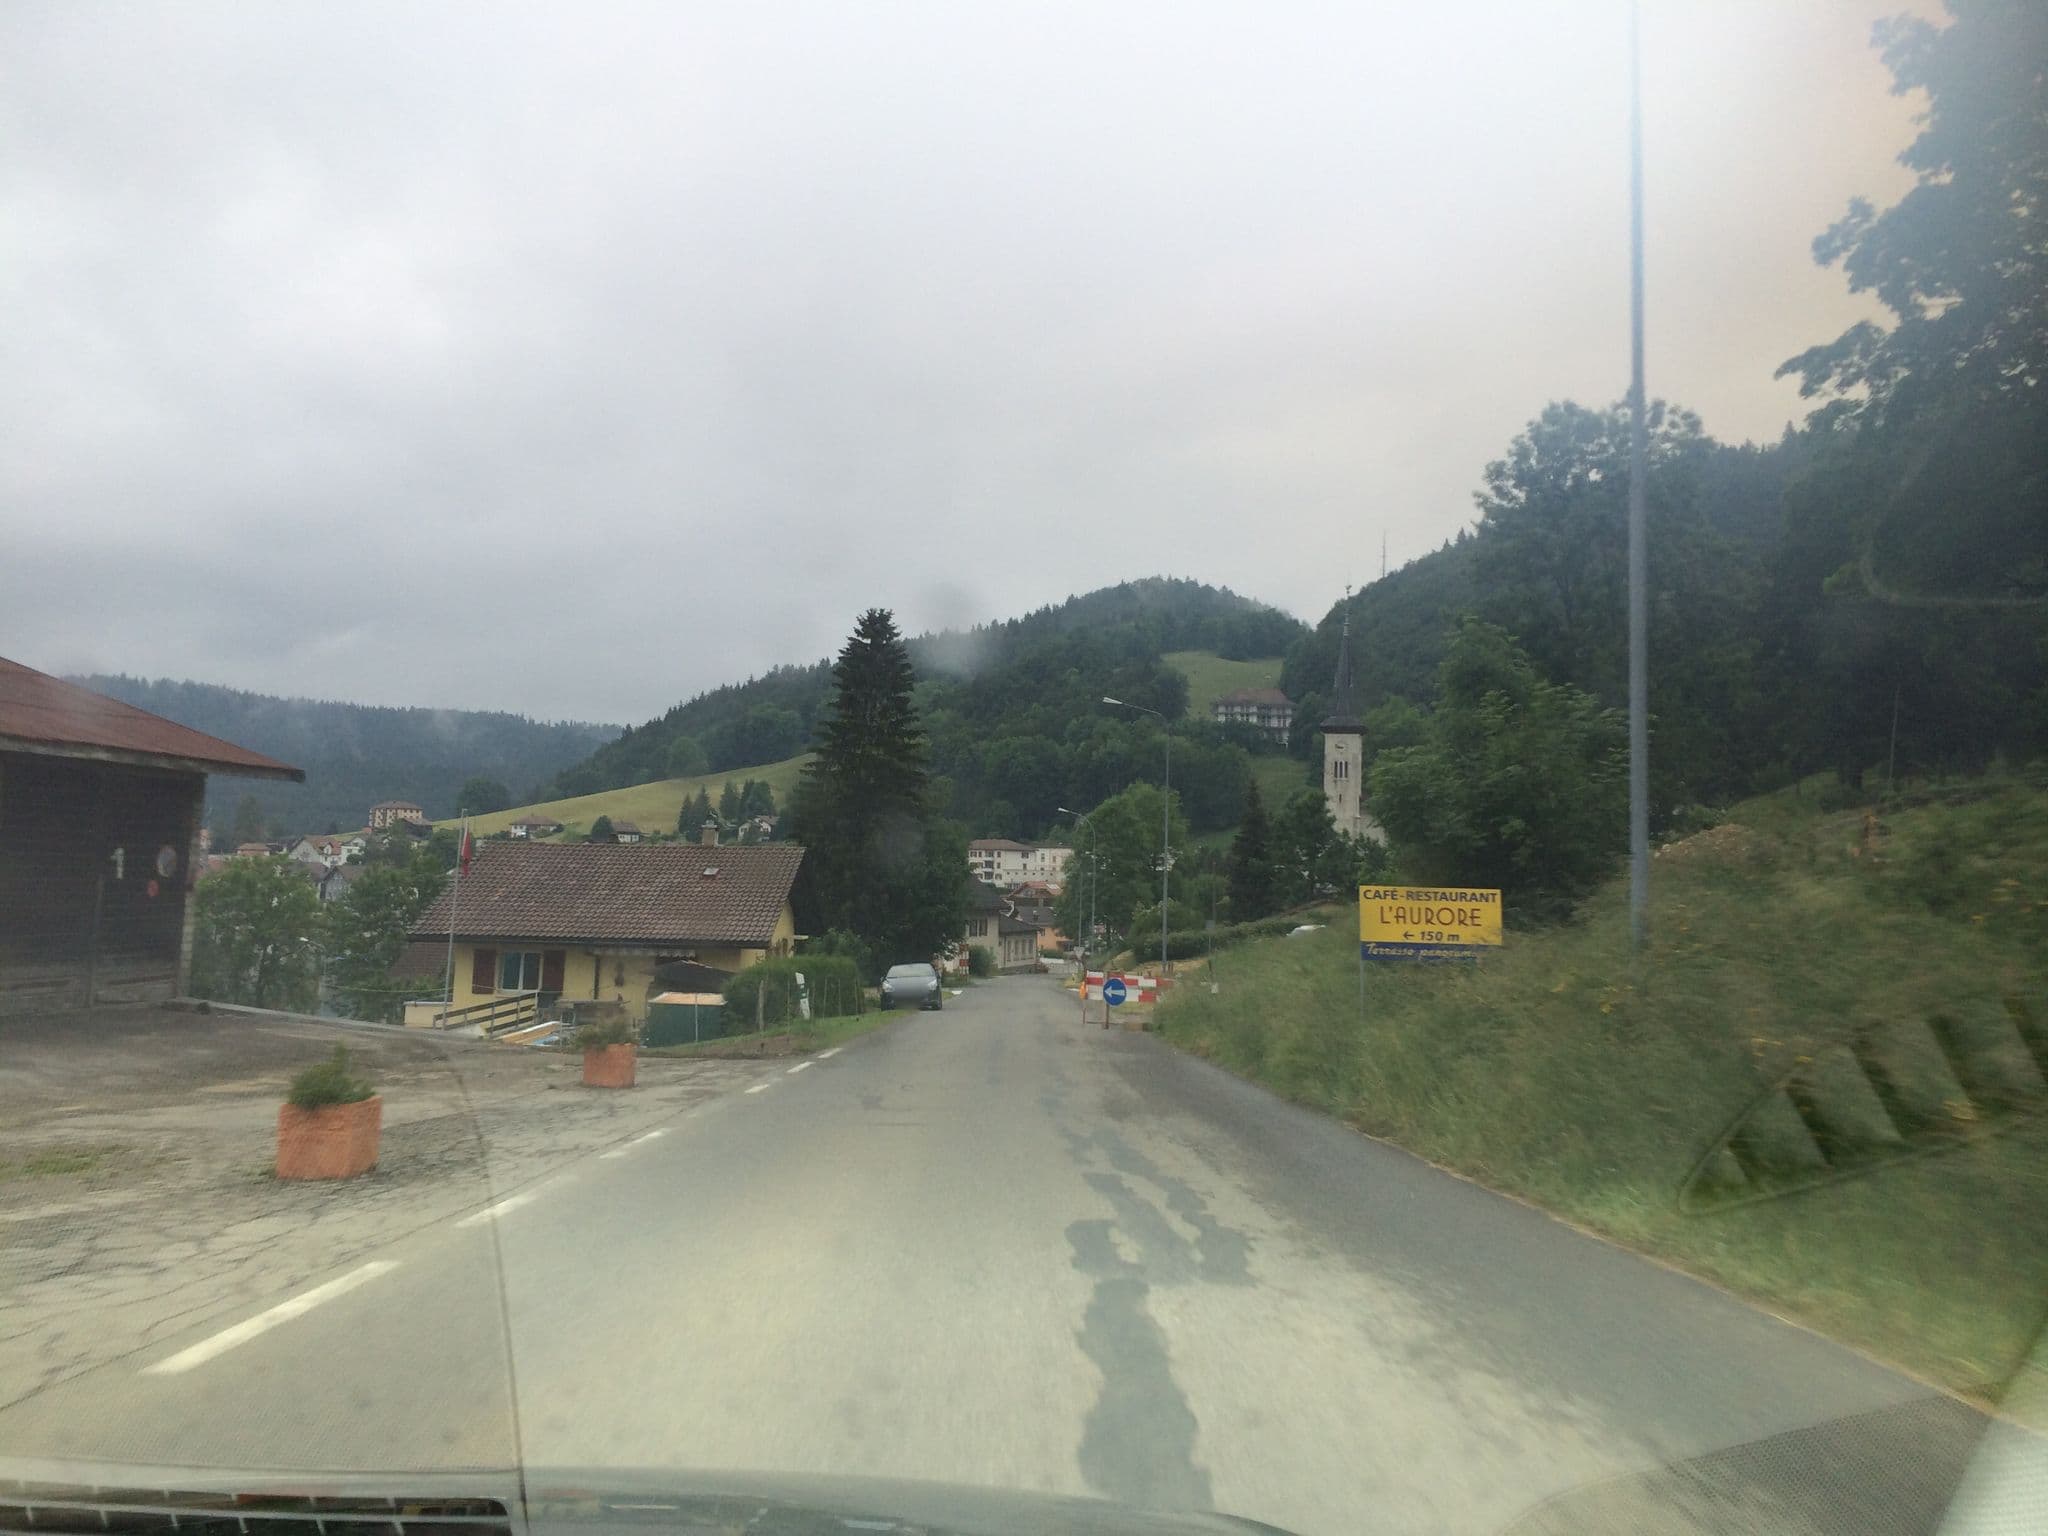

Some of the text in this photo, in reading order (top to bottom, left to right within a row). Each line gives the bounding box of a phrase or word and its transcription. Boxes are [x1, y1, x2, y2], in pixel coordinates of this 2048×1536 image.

[1380, 906, 1482, 927] L'AURORE
[1420, 931, 1460, 942] 150 m
